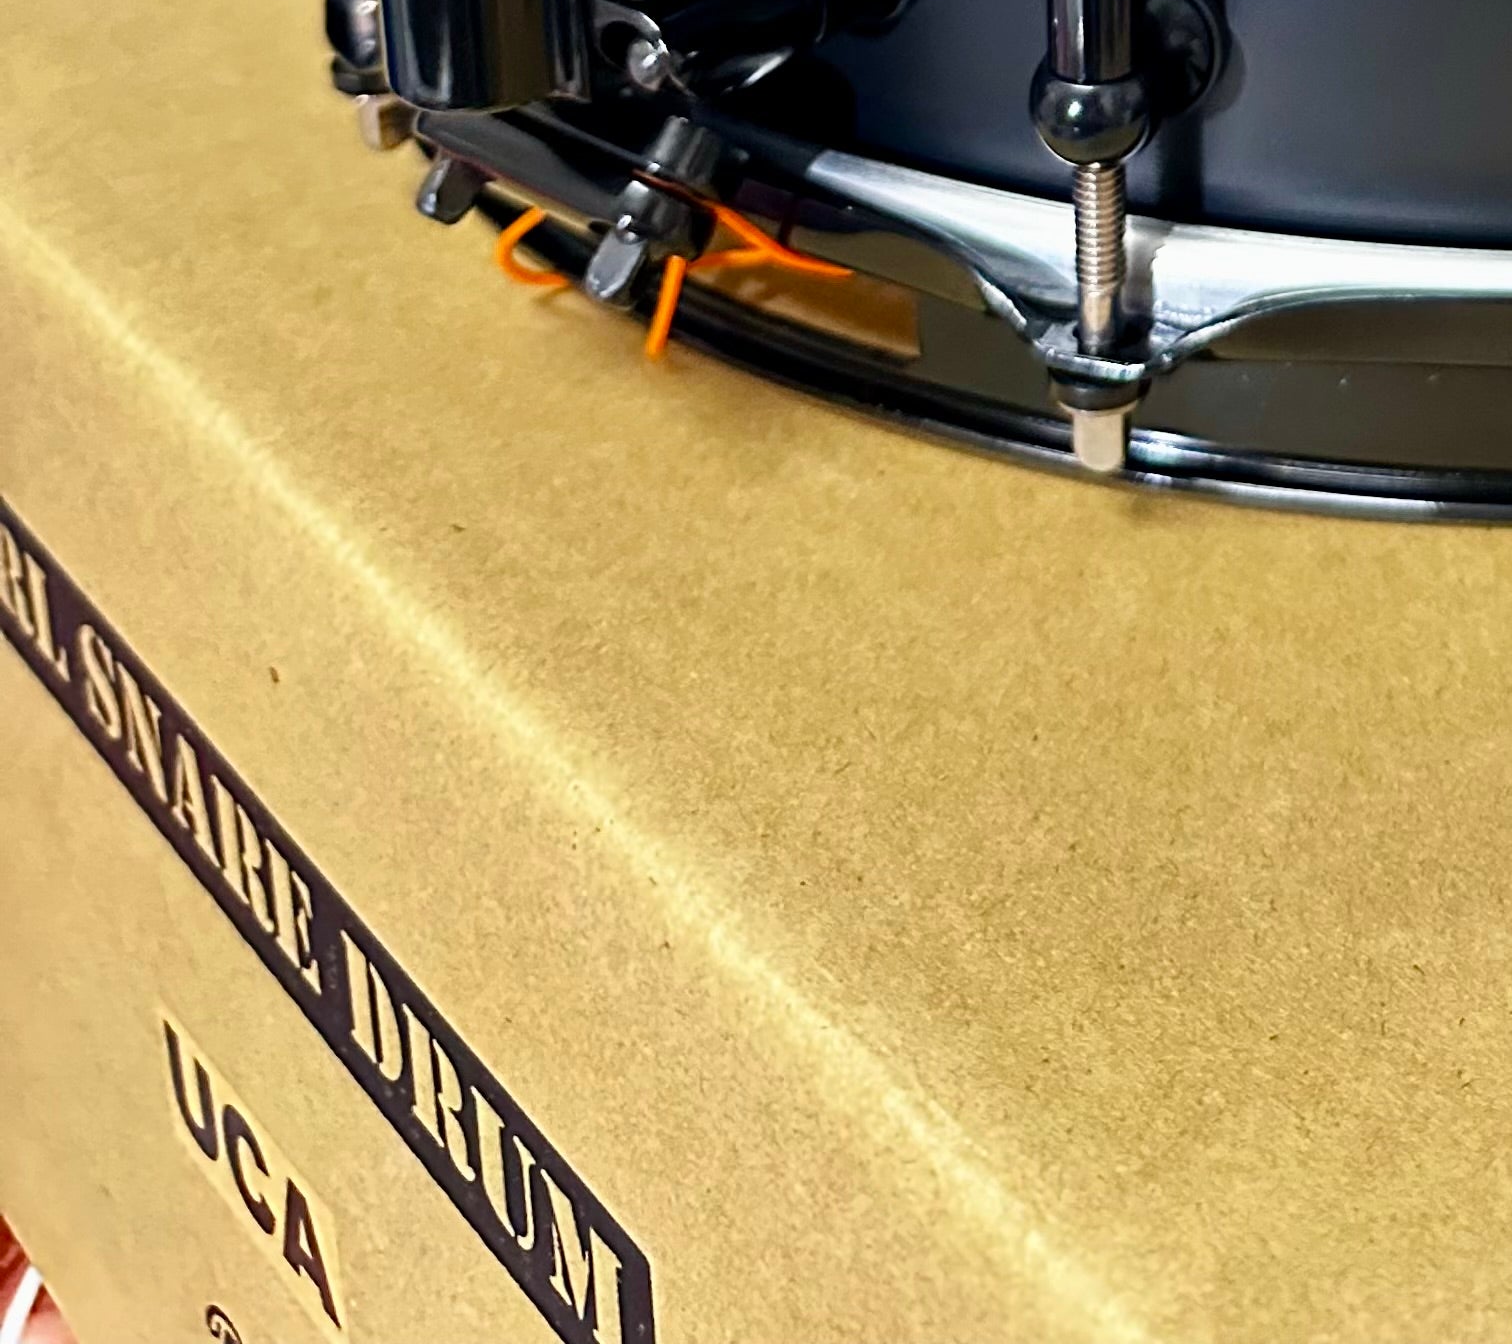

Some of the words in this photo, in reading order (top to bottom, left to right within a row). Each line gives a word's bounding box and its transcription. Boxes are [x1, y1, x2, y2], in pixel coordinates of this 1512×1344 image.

[76, 623, 322, 995] SNARE
[340, 929, 623, 1344] DRUM
[162, 1019, 341, 1330] UCA
